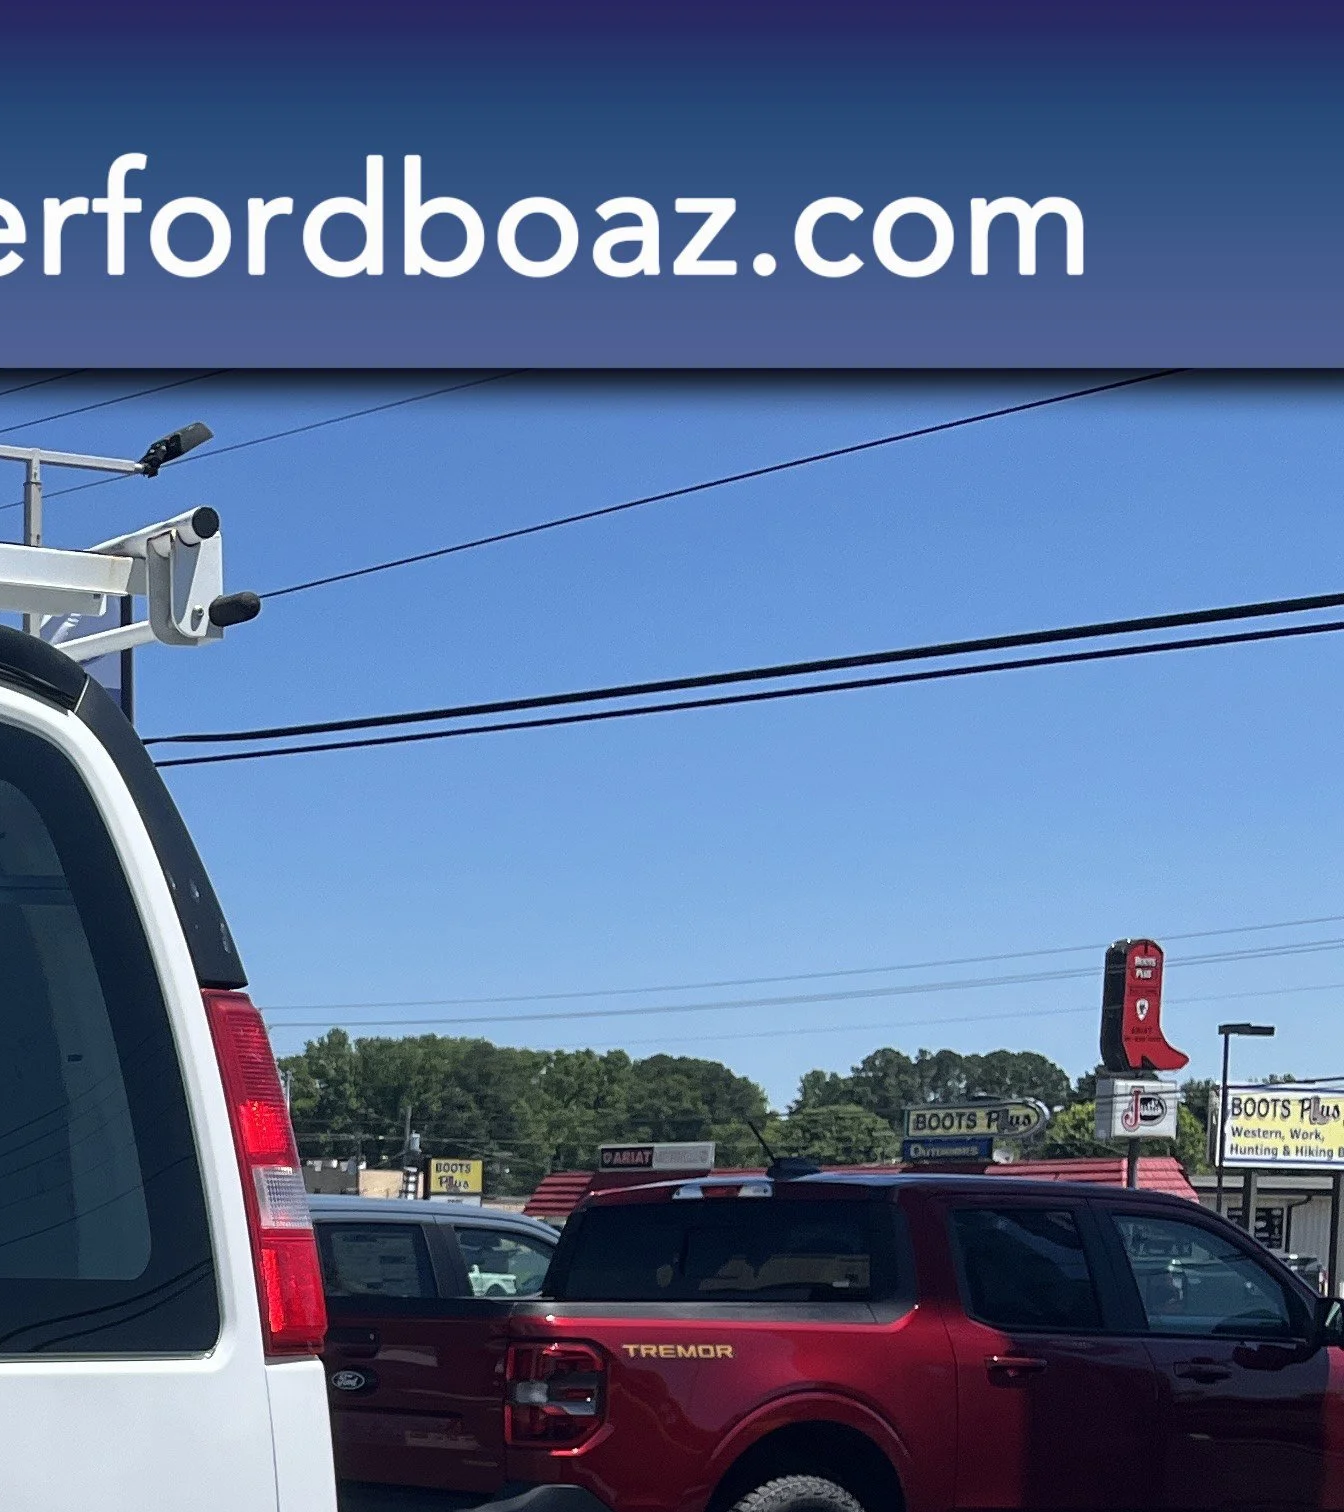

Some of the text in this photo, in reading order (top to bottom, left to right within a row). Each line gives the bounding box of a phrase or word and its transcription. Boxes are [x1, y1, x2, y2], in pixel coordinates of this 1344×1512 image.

[1231, 1096, 1340, 1125] BOOTS Plus
[915, 1109, 1031, 1133] BOOTS Plus
[1231, 1126, 1325, 1143] Western, Work,
[1230, 1144, 1278, 1158] Hunting
[1282, 1146, 1291, 1156] &
[1295, 1145, 1334, 1160] Hiking
[434, 1162, 472, 1174] BOOTS
[622, 1343, 735, 1359] TREMOR
